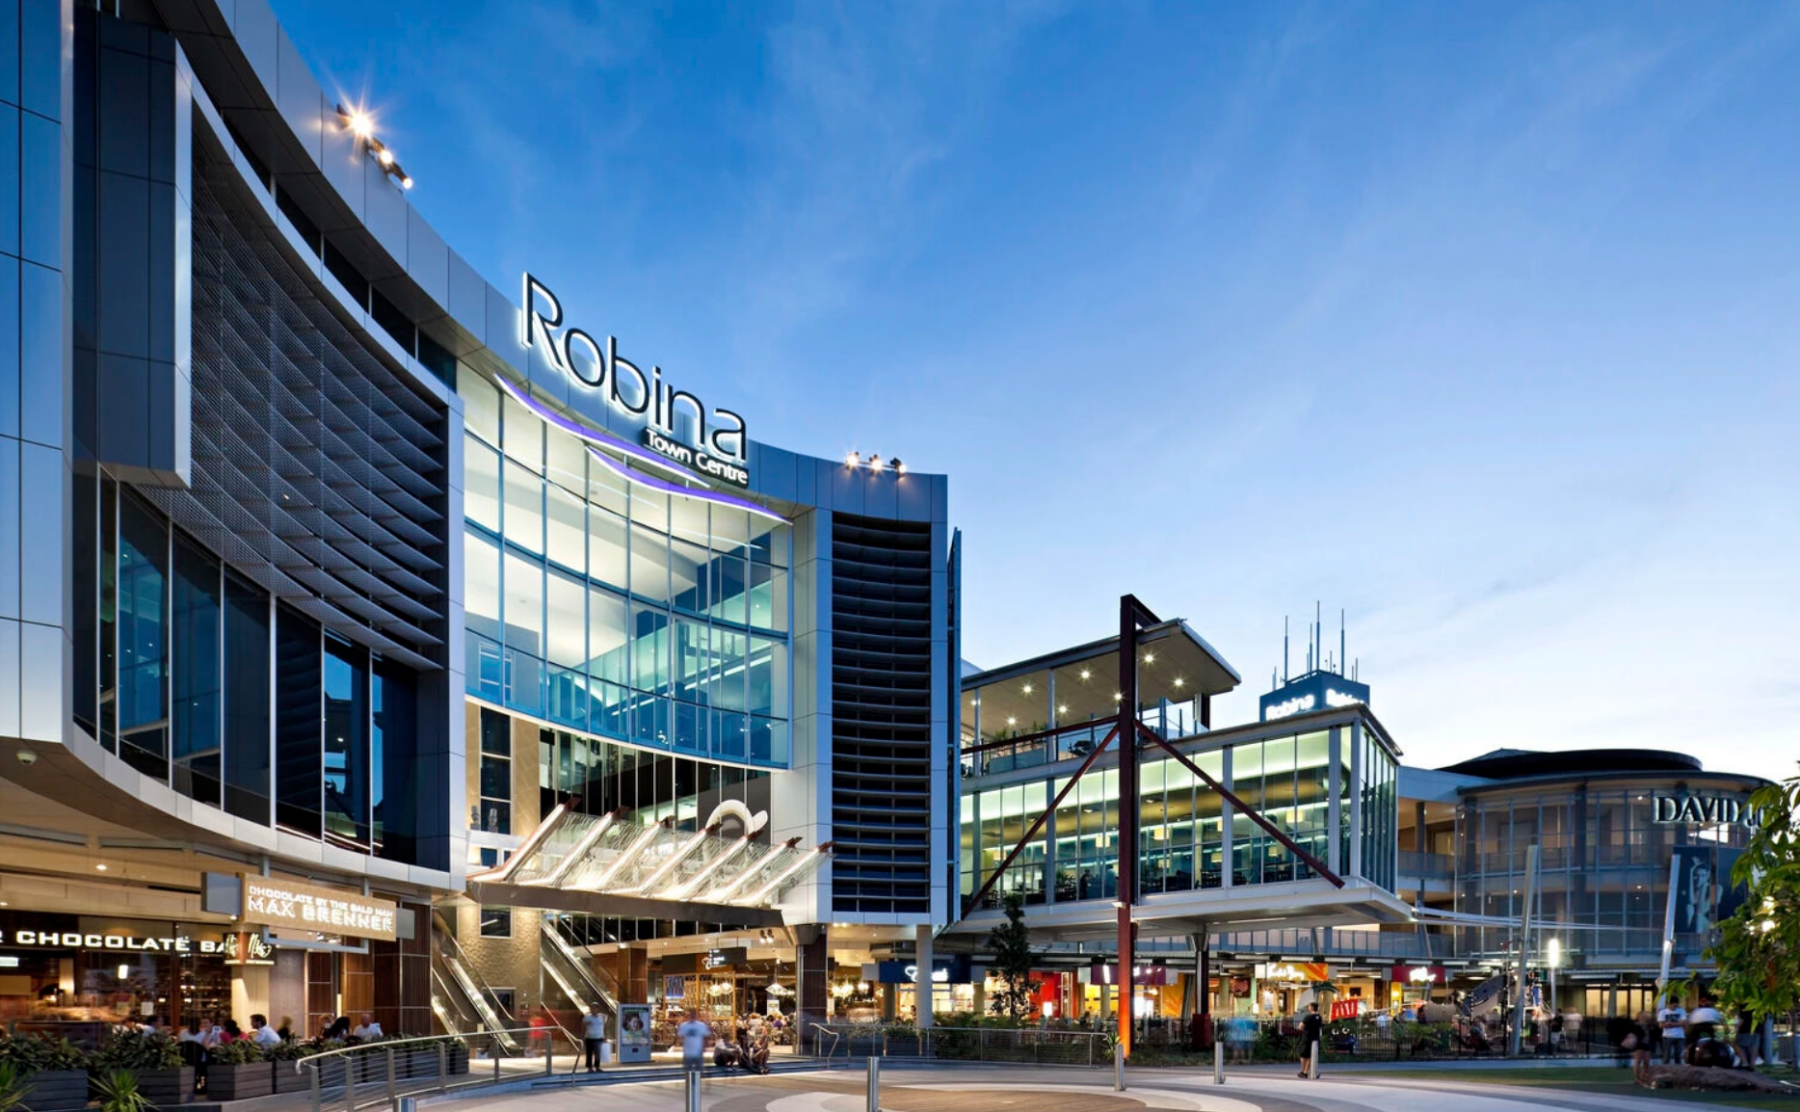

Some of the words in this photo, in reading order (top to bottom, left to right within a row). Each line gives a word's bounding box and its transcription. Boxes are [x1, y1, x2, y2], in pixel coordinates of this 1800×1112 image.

[520, 271, 747, 464] Robina
[645, 427, 692, 464] Town
[695, 451, 749, 485] Centre
[1653, 796, 1741, 823] DAVID
[248, 895, 296, 919] MAX
[302, 904, 393, 933] BRENNER
[315, 897, 329, 907] BY
[330, 899, 349, 912] THE
[350, 903, 373, 915] BALD
[16, 931, 190, 951] CHOCOLATE
